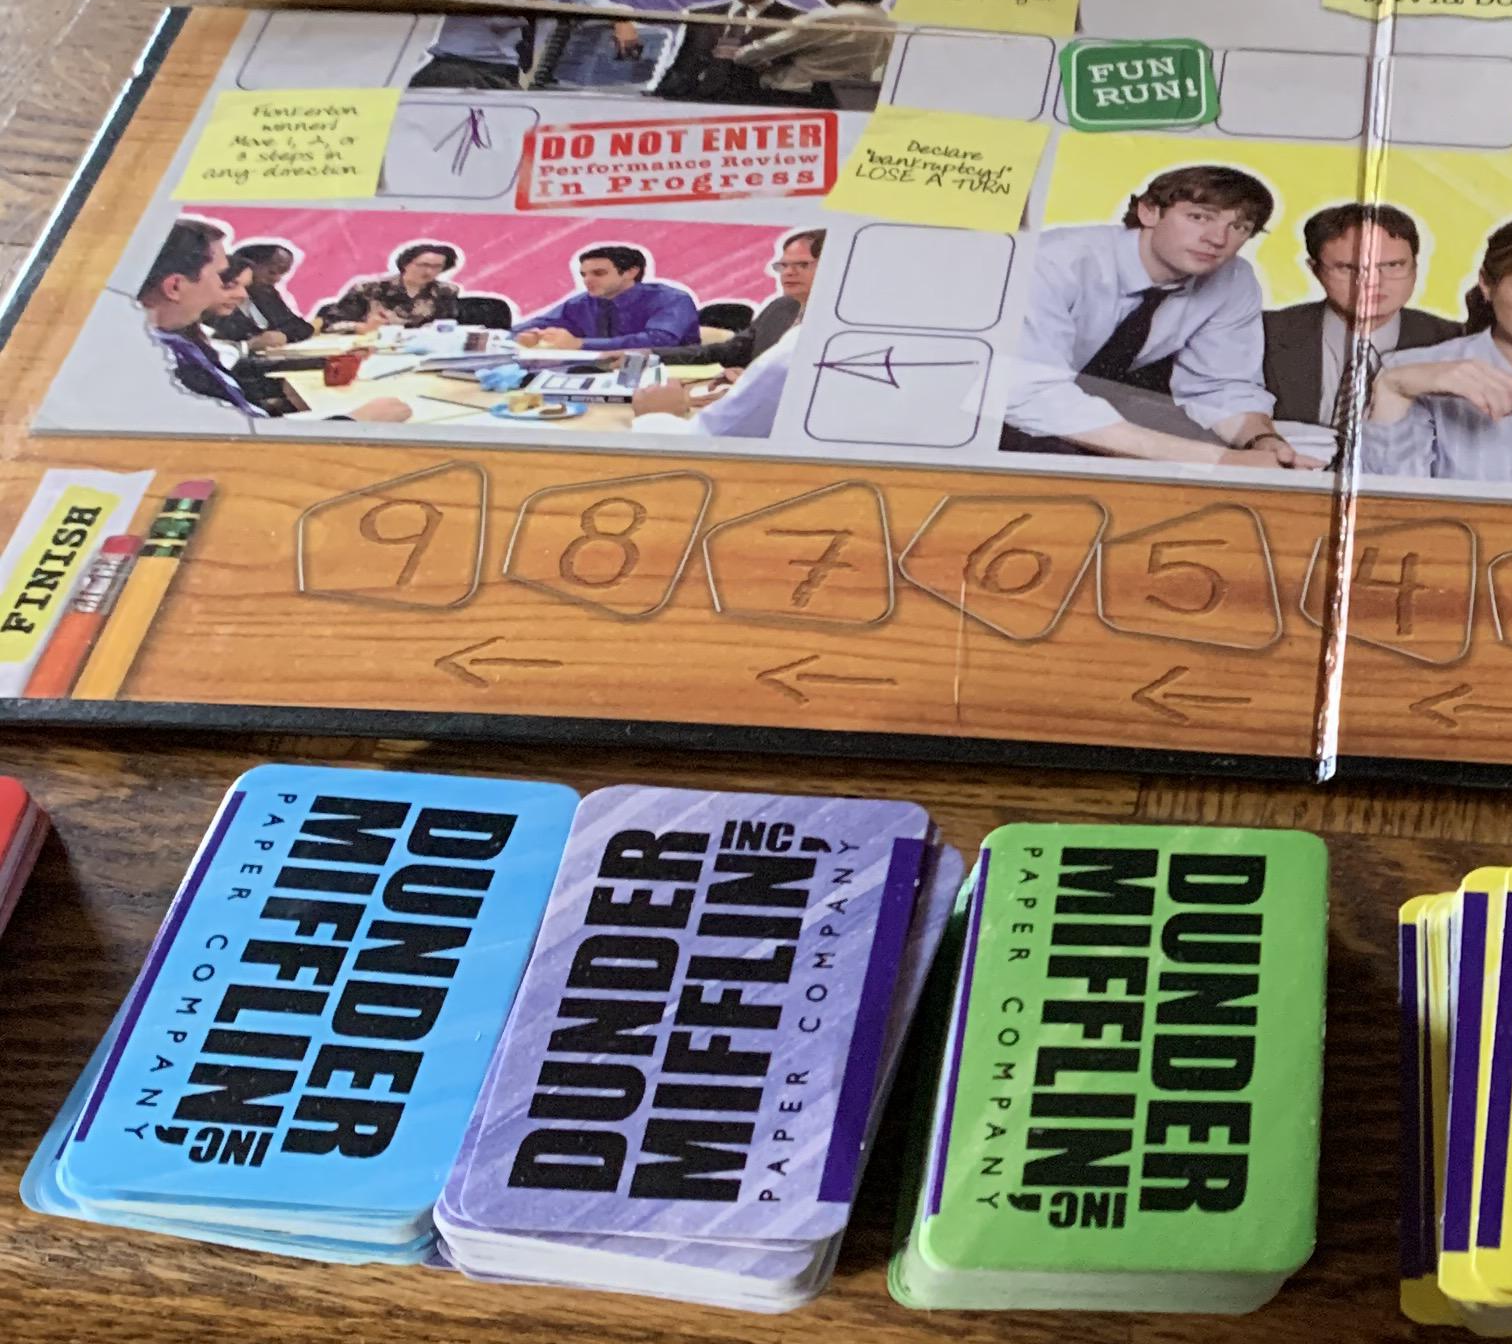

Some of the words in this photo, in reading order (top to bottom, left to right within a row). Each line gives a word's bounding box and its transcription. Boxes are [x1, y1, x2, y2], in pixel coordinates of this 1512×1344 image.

[1087, 56, 1176, 84] FUN
[1093, 76, 1198, 107] RUN!
[539, 157, 712, 178] Performance
[720, 152, 820, 168] Review
[541, 135, 595, 161] DO
[610, 129, 689, 157] NOT
[702, 123, 822, 152] ENTER
[855, 164, 916, 184] LOSE
[925, 173, 943, 189] A
[952, 177, 1012, 196] TURN
[907, 139, 984, 162] Declare
[537, 179, 585, 198] In
[607, 170, 816, 195] Progress
[0, 506, 103, 634] FINISH
[360, 498, 443, 588] 9
[560, 497, 648, 590] 8
[765, 528, 857, 608] 7
[962, 513, 1053, 595] 6
[1146, 538, 1231, 614] 5
[1351, 546, 1426, 636] 4
[226, 792, 298, 902] PAPER
[720, 819, 796, 853] INC
[1006, 845, 1044, 964] PAPER
[283, 807, 518, 1160] DUNDER
[507, 819, 711, 1194] DUNDER
[758, 1068, 810, 1203] PAPER
[798, 837, 861, 1033] COMPANY
[123, 933, 227, 1142] COMPANY
[1139, 853, 1267, 1215] DUNDER
[979, 996, 1025, 1211] COMPANY
[189, 1127, 272, 1168] INC
[1049, 1191, 1127, 1230] INC
